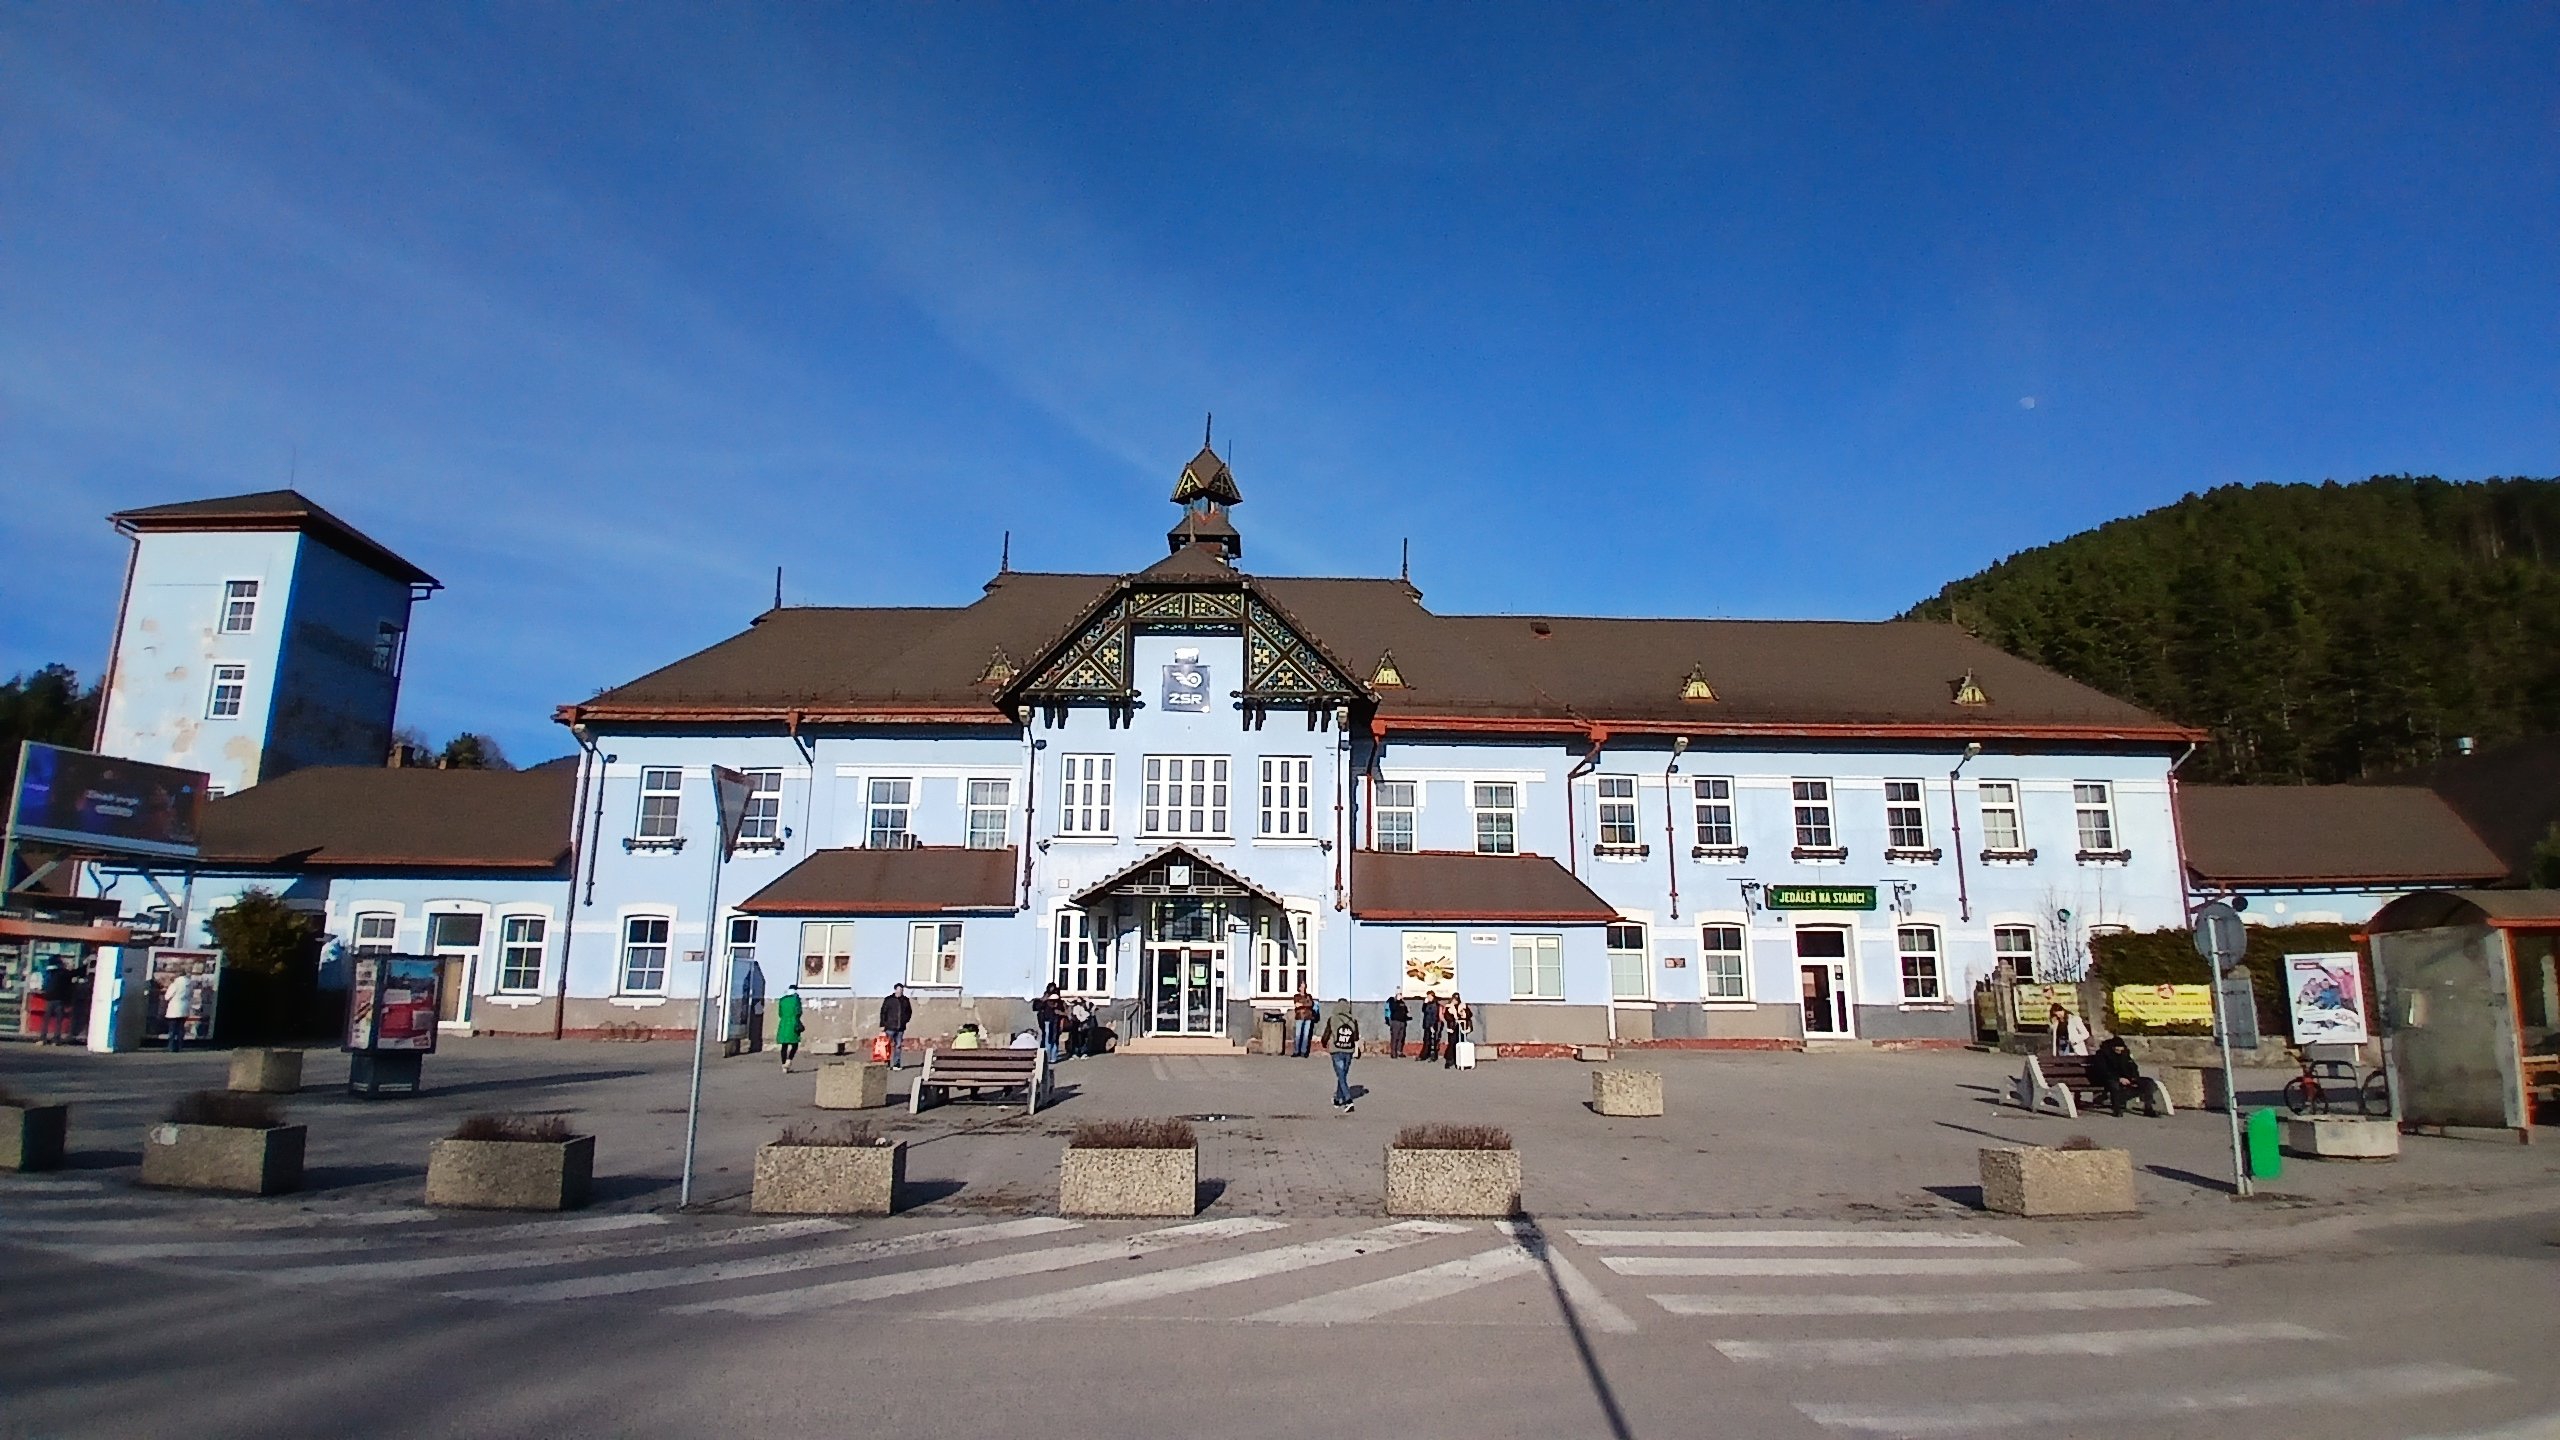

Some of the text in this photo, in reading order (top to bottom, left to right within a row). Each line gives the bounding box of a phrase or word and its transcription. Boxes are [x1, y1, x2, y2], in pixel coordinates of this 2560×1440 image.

[1779, 890, 1865, 903] JEDÁLEŇ NA STANICI
